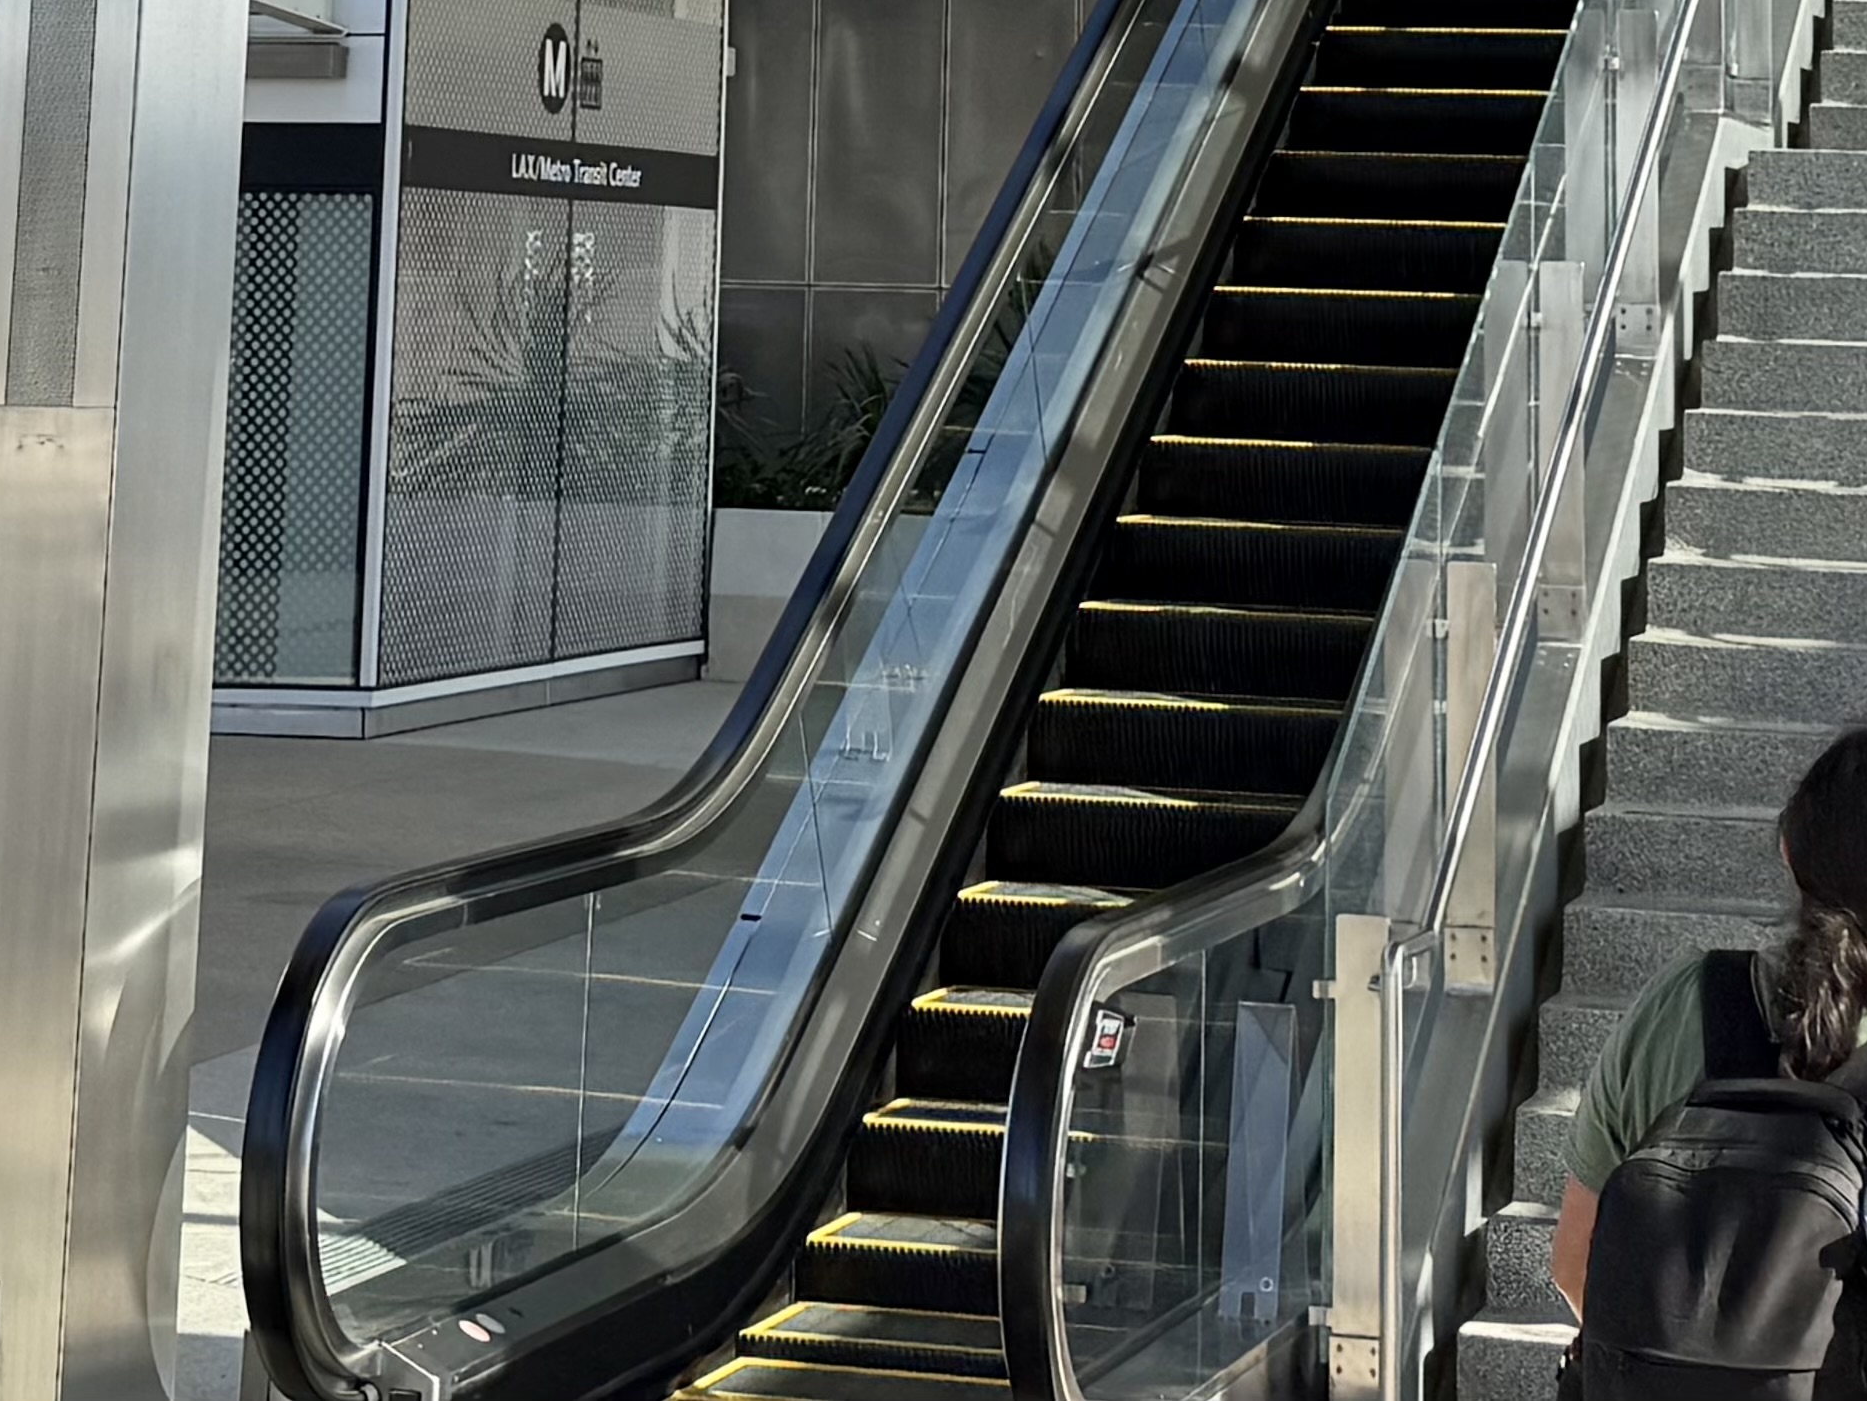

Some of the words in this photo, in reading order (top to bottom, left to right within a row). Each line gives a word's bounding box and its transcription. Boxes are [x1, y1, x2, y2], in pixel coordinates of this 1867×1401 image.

[543, 38, 567, 98] M
[512, 153, 572, 182] LAX/Metro
[573, 158, 607, 186] Transit
[609, 161, 642, 187] Center
